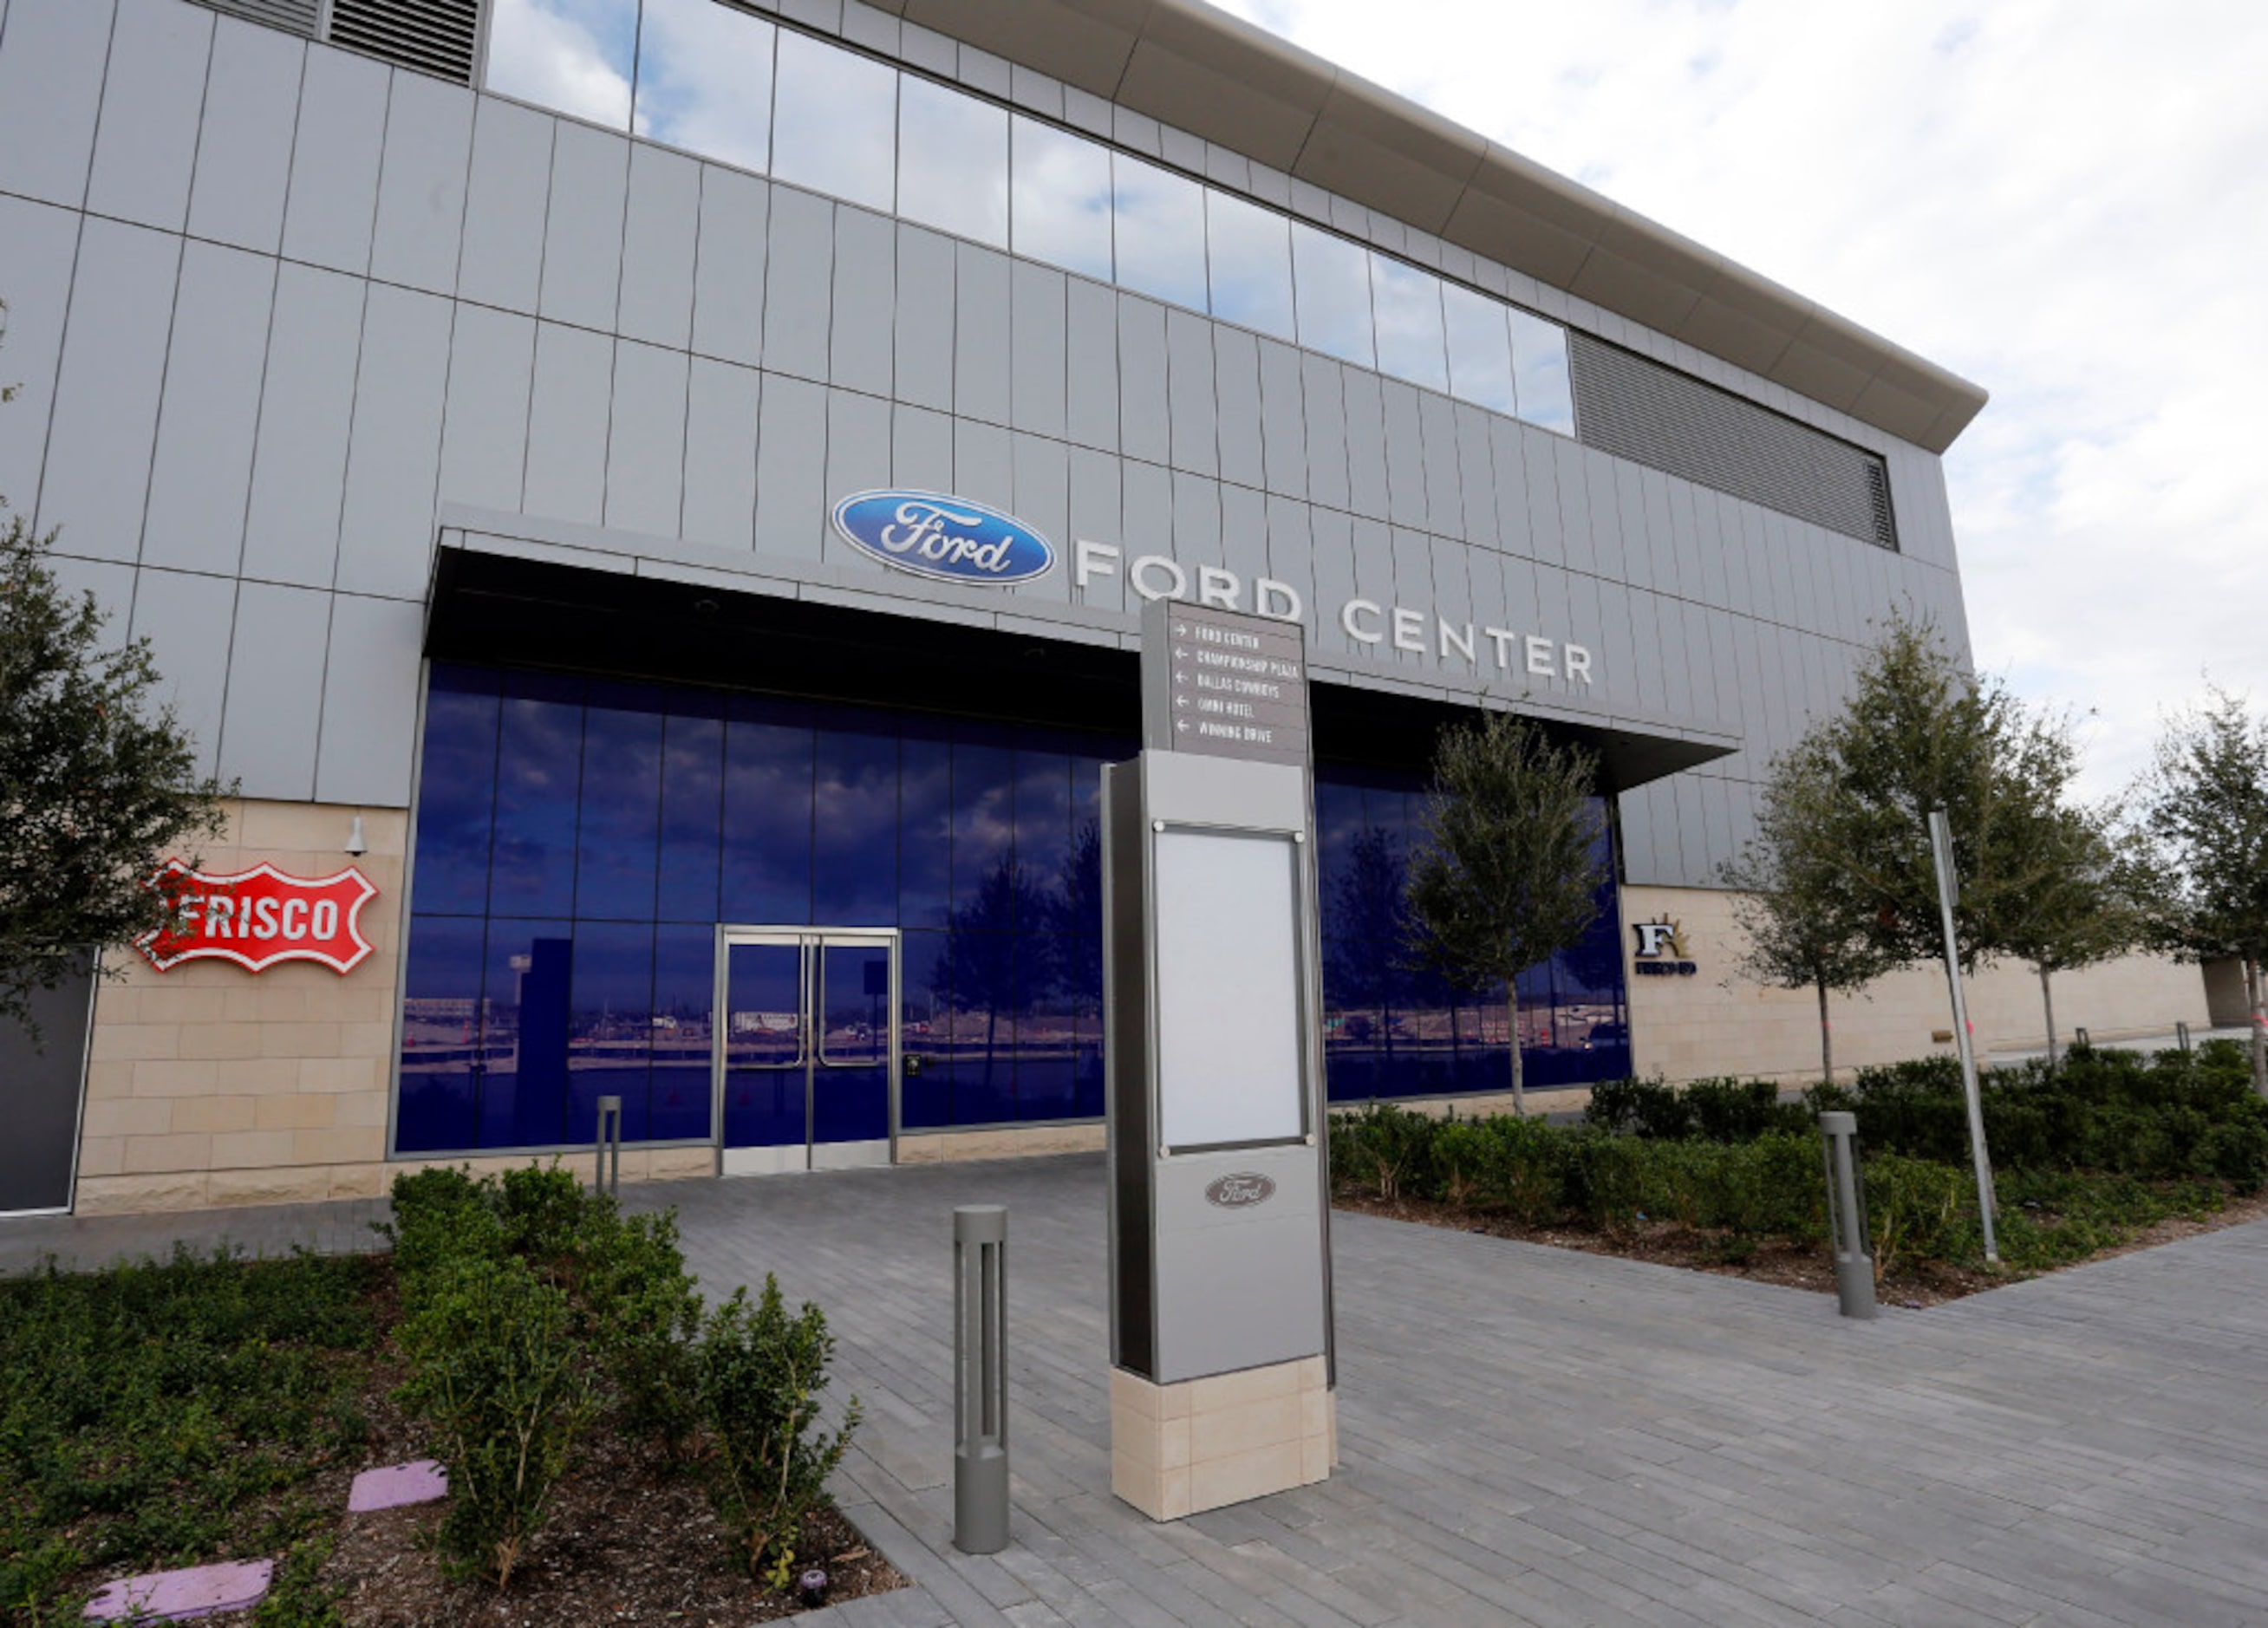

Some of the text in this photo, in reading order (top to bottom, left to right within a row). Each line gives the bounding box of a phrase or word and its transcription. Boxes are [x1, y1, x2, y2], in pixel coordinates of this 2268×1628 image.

[881, 502, 1013, 572] Ford
[1075, 539, 1593, 684] FORD CENTER
[1224, 633, 1260, 650] CENTER
[1197, 674, 1232, 692] DALLAS
[177, 894, 339, 941] FRISCO
